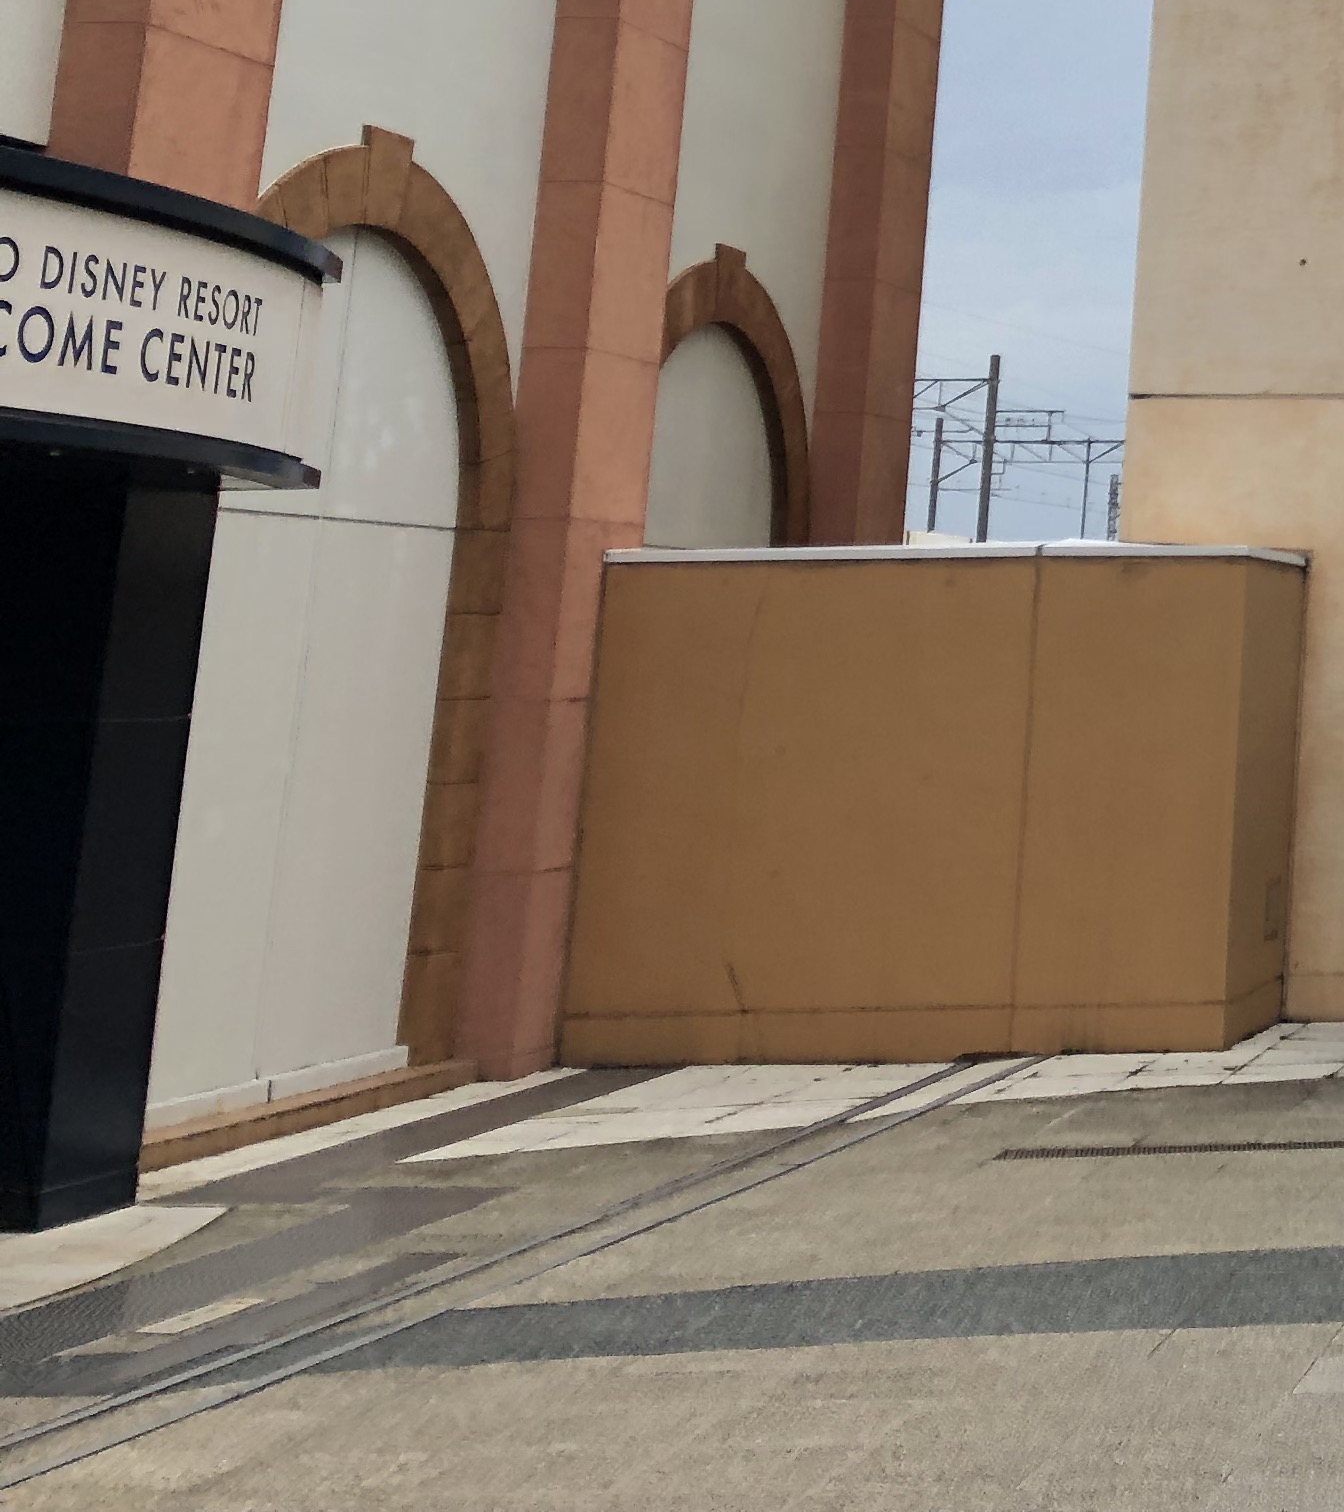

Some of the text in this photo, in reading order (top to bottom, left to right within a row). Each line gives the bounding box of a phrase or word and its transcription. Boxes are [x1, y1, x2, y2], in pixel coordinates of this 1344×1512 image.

[40, 245, 167, 312] DISNEY
[177, 276, 263, 337] RESORT
[140, 328, 256, 403] CENTER
